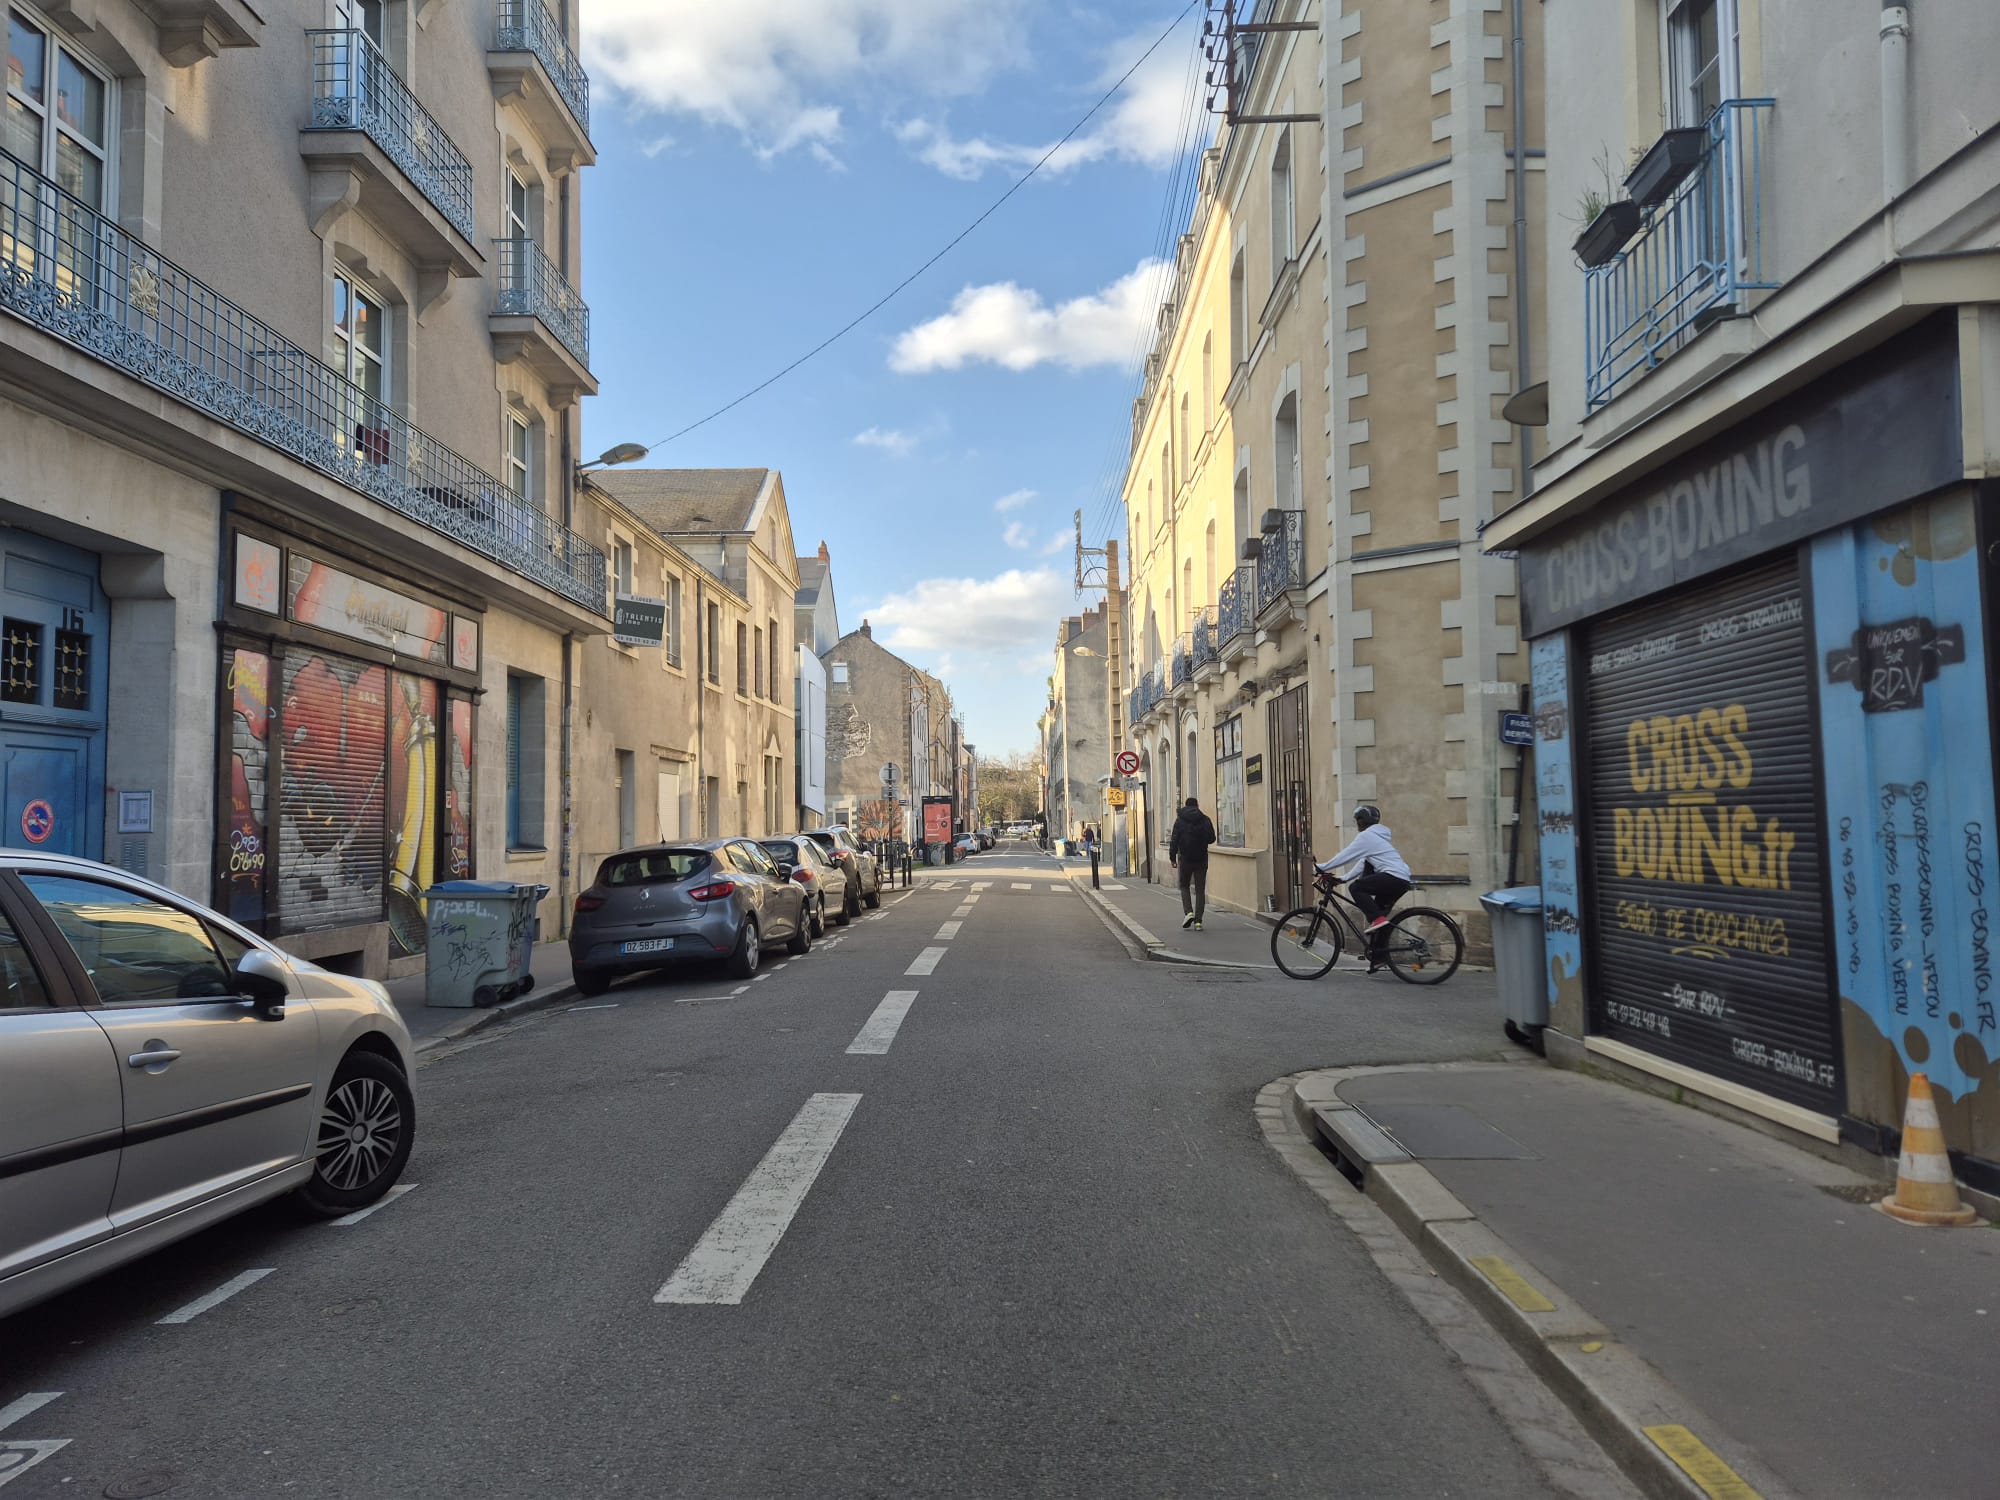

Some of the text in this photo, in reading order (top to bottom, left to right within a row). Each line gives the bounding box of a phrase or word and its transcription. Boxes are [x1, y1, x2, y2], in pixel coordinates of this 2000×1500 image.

[1546, 424, 1811, 613] CROSS-BOXING
[1628, 704, 1752, 792] CROSS
[1613, 804, 1795, 890] BOXING.fr
[1840, 816, 1852, 841] 06
[1664, 908, 1687, 939] DE
[1882, 821, 1898, 876] CROSS
[1893, 957, 1909, 1016] VERTOU
[1964, 821, 1997, 1033] CROSS-BOXING.FR
